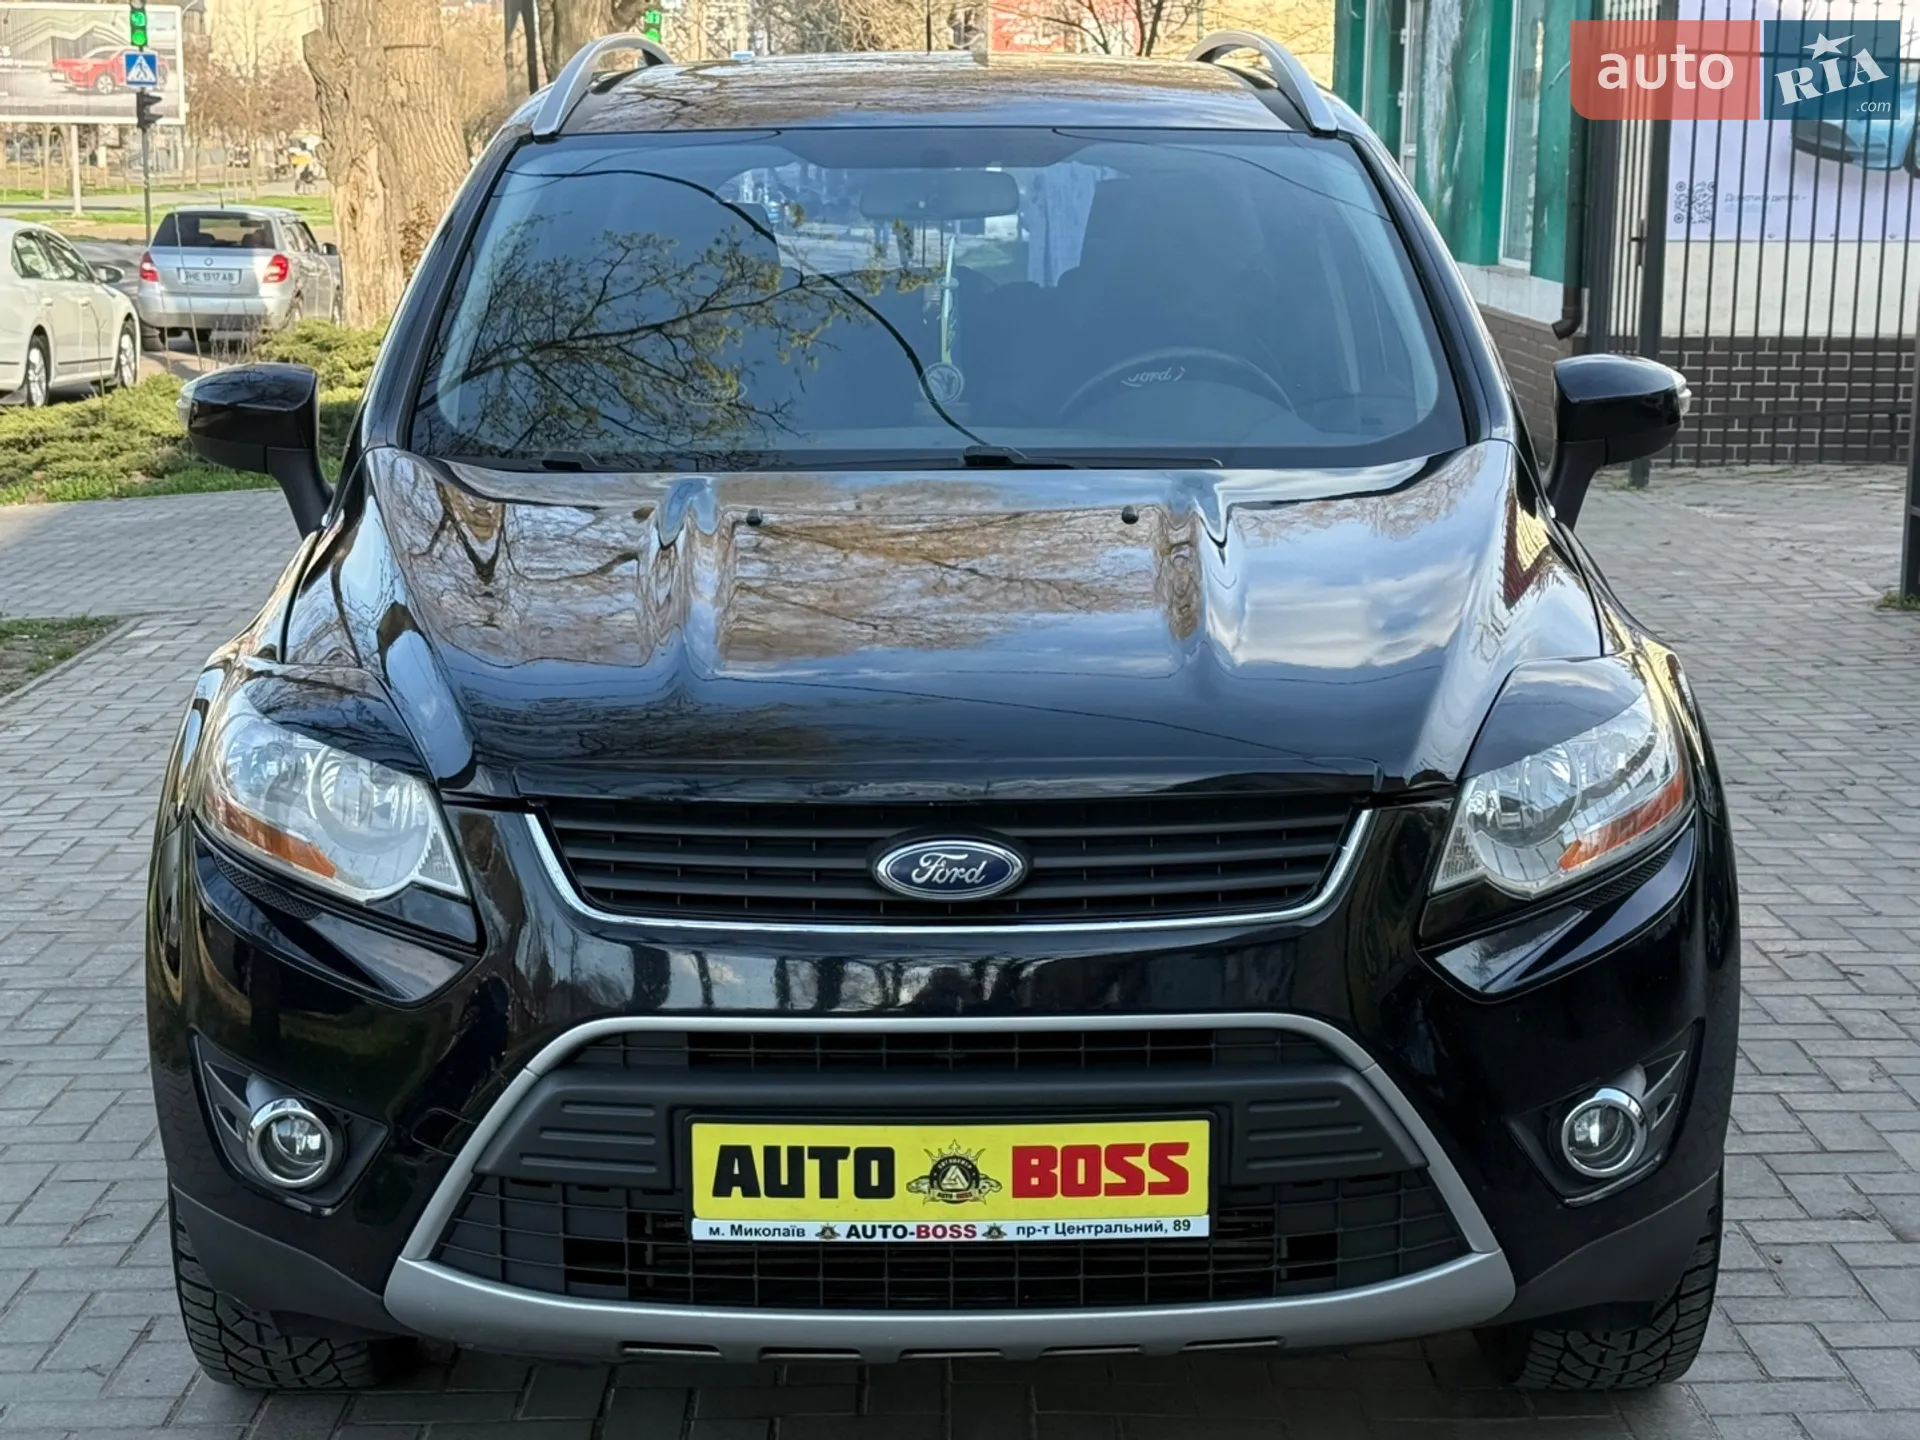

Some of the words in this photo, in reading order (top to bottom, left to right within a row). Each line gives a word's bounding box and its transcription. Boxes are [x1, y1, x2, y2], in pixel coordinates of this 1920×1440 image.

[911, 852, 988, 884] Ford
[712, 1144, 896, 1199] AUTO
[1011, 1142, 1190, 1199] BOSS
[708, 1226, 725, 1237] м.
[730, 1224, 806, 1238] Миколаїв
[846, 1224, 978, 1240] AUTO-BOSS
[1016, 1225, 1050, 1239] пр-т
[1055, 1219, 1168, 1236] Центральний,
[1173, 1219, 1191, 1232] 89
